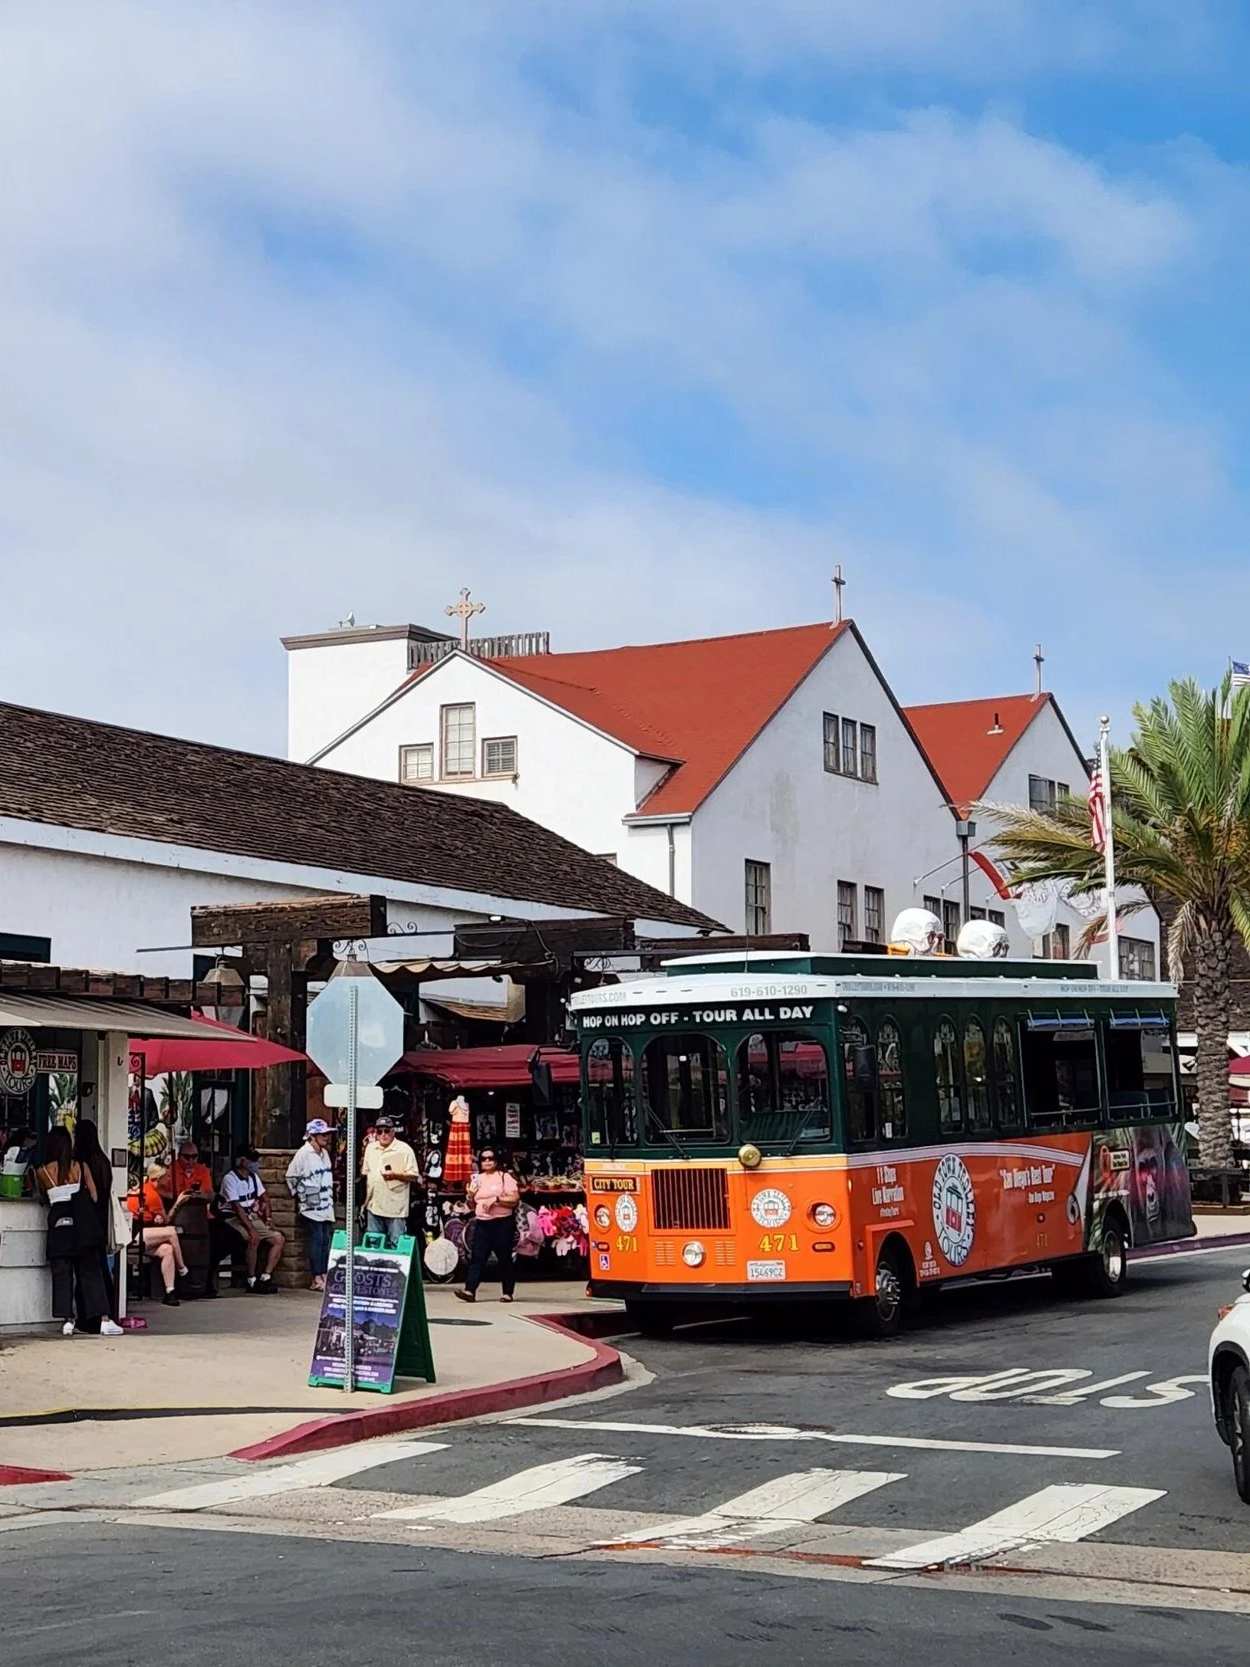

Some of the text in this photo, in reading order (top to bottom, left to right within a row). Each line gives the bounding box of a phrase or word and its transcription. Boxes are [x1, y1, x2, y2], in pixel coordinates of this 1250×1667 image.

[730, 984, 808, 997] 619-610-1290
[582, 1016, 603, 1028] HOP
[605, 1015, 619, 1027] ON
[621, 1013, 646, 1026] HOP
[650, 1012, 679, 1025] OFF
[692, 1009, 737, 1023] TOUR
[742, 1008, 775, 1021] ALL
[779, 1006, 814, 1019] DAY
[38, 1055, 77, 1070] FREE MAPS
[593, 1179, 635, 1190] CITY TOUR
[616, 1235, 638, 1252] 471
[759, 1233, 799, 1252] 471
[333, 1269, 392, 1288] GOSTS
[886, 1368, 1210, 1408] STOP
